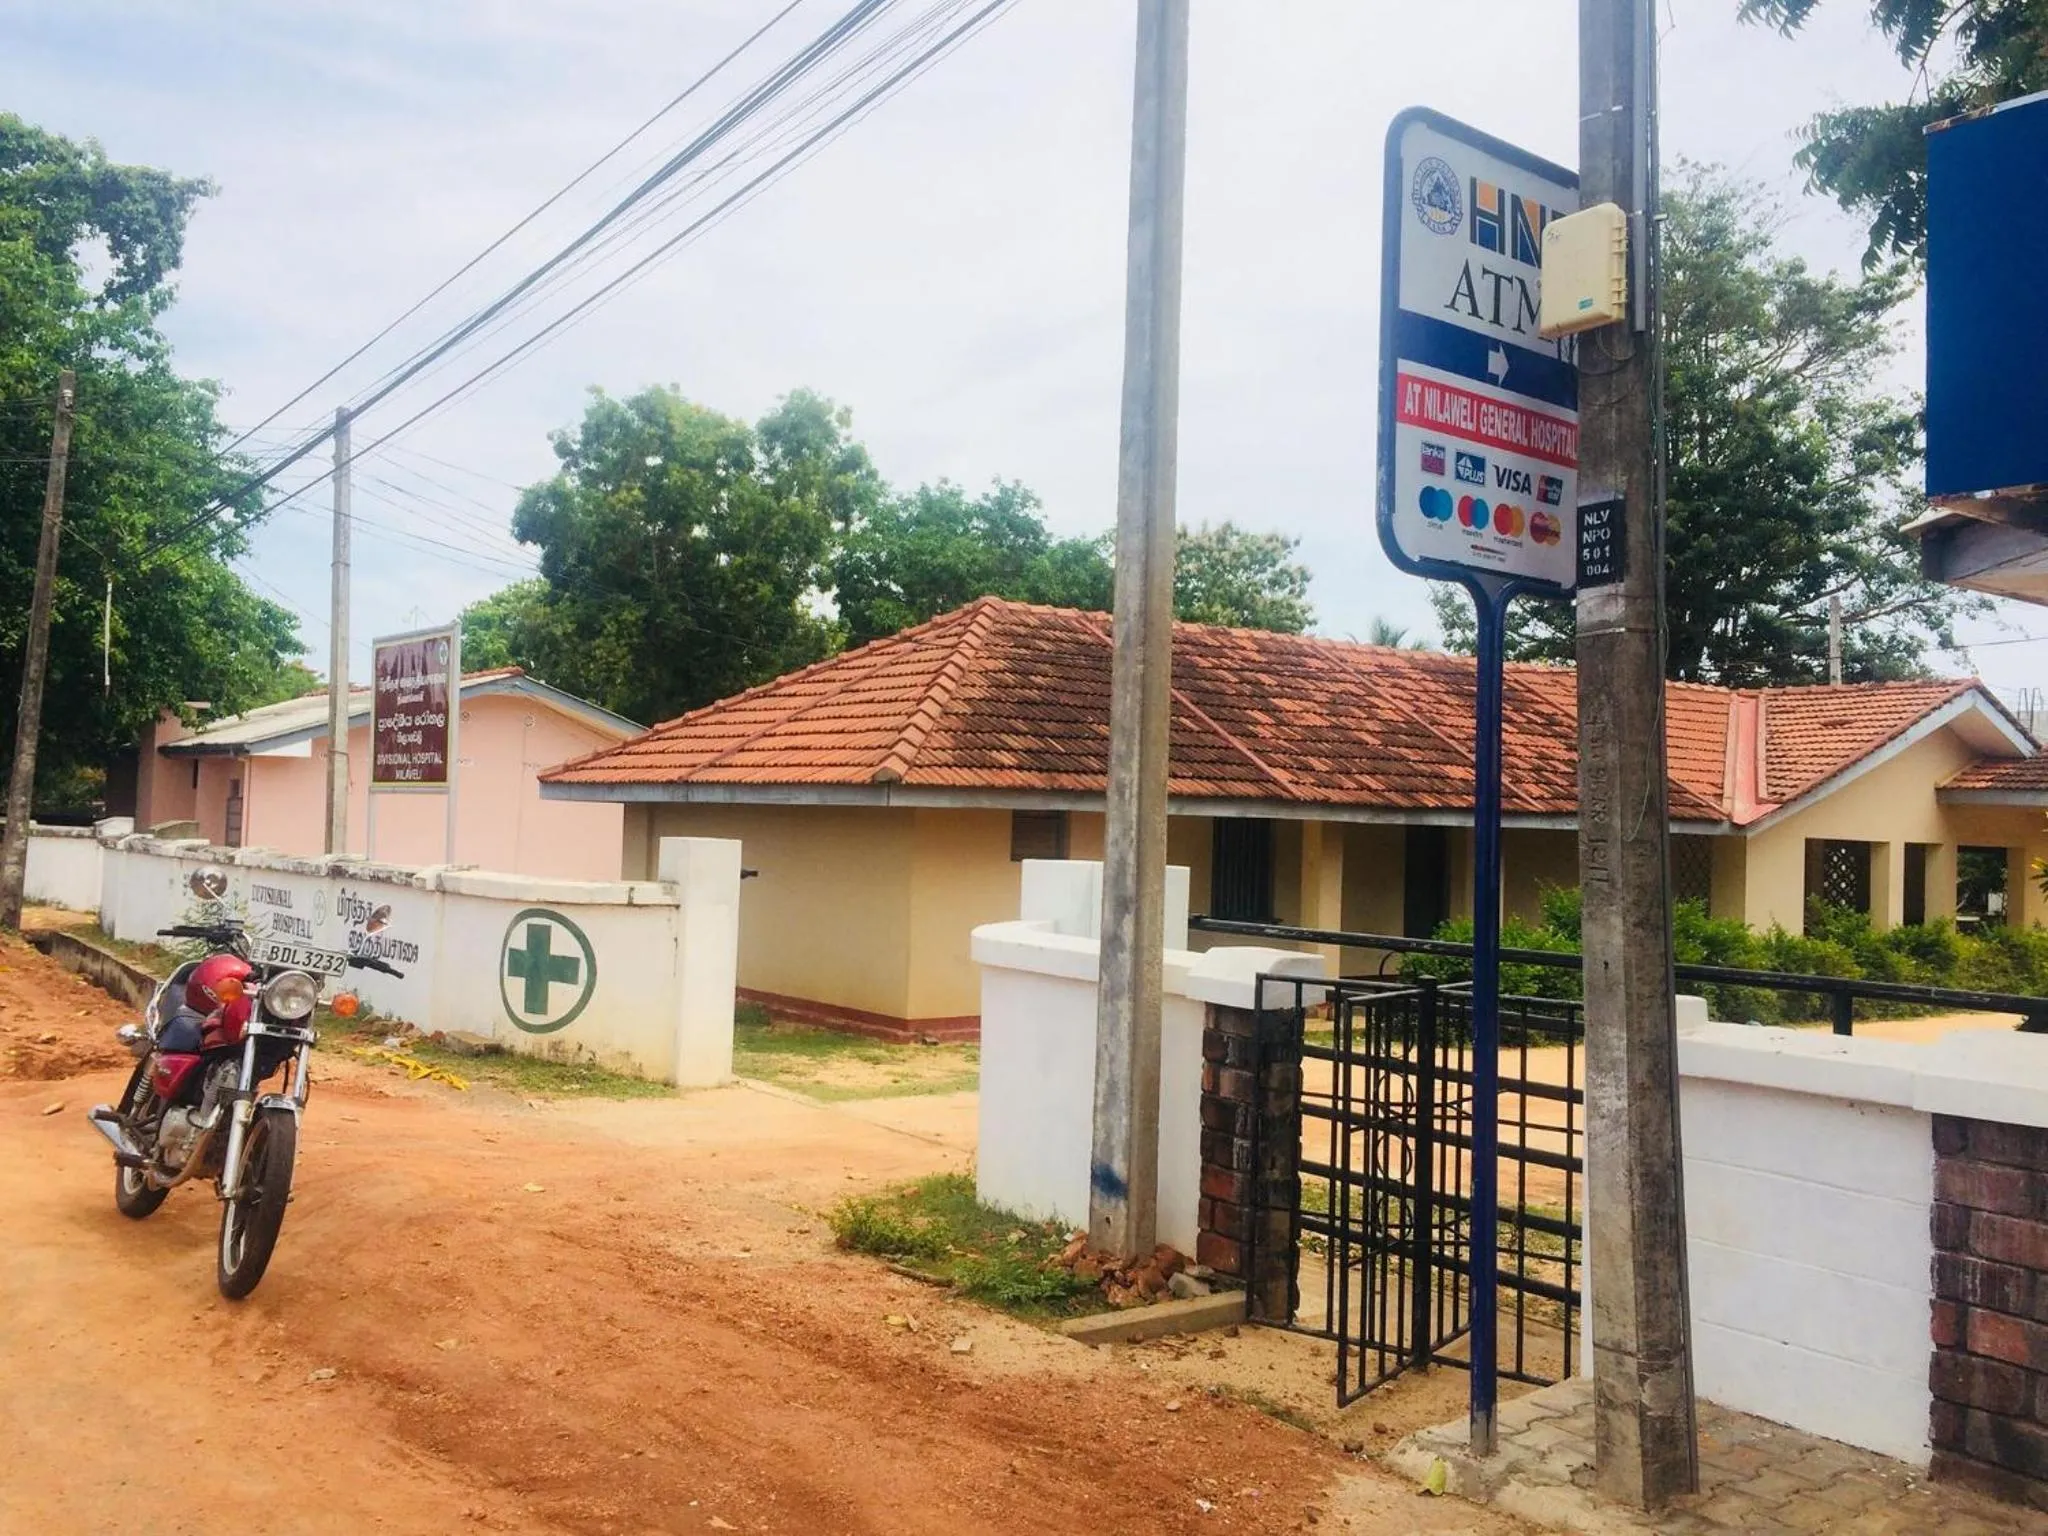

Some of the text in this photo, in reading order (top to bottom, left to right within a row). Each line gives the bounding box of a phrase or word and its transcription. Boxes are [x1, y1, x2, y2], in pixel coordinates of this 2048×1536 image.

[1470, 176, 1567, 269] HN
[1404, 382, 1577, 460] AT NILAWELI GENERAL HOSPITAL
[1463, 469, 1484, 483] PLUS
[1492, 464, 1532, 496] VISA
[1584, 508, 1610, 526] NLV
[1583, 528, 1611, 544] NPO
[1586, 563, 1610, 576] 004
[377, 752, 442, 765] DIVISIONAL HOSPITAL
[252, 884, 293, 909] DIVISIONAL
[272, 912, 313, 939] HOSPITAL
